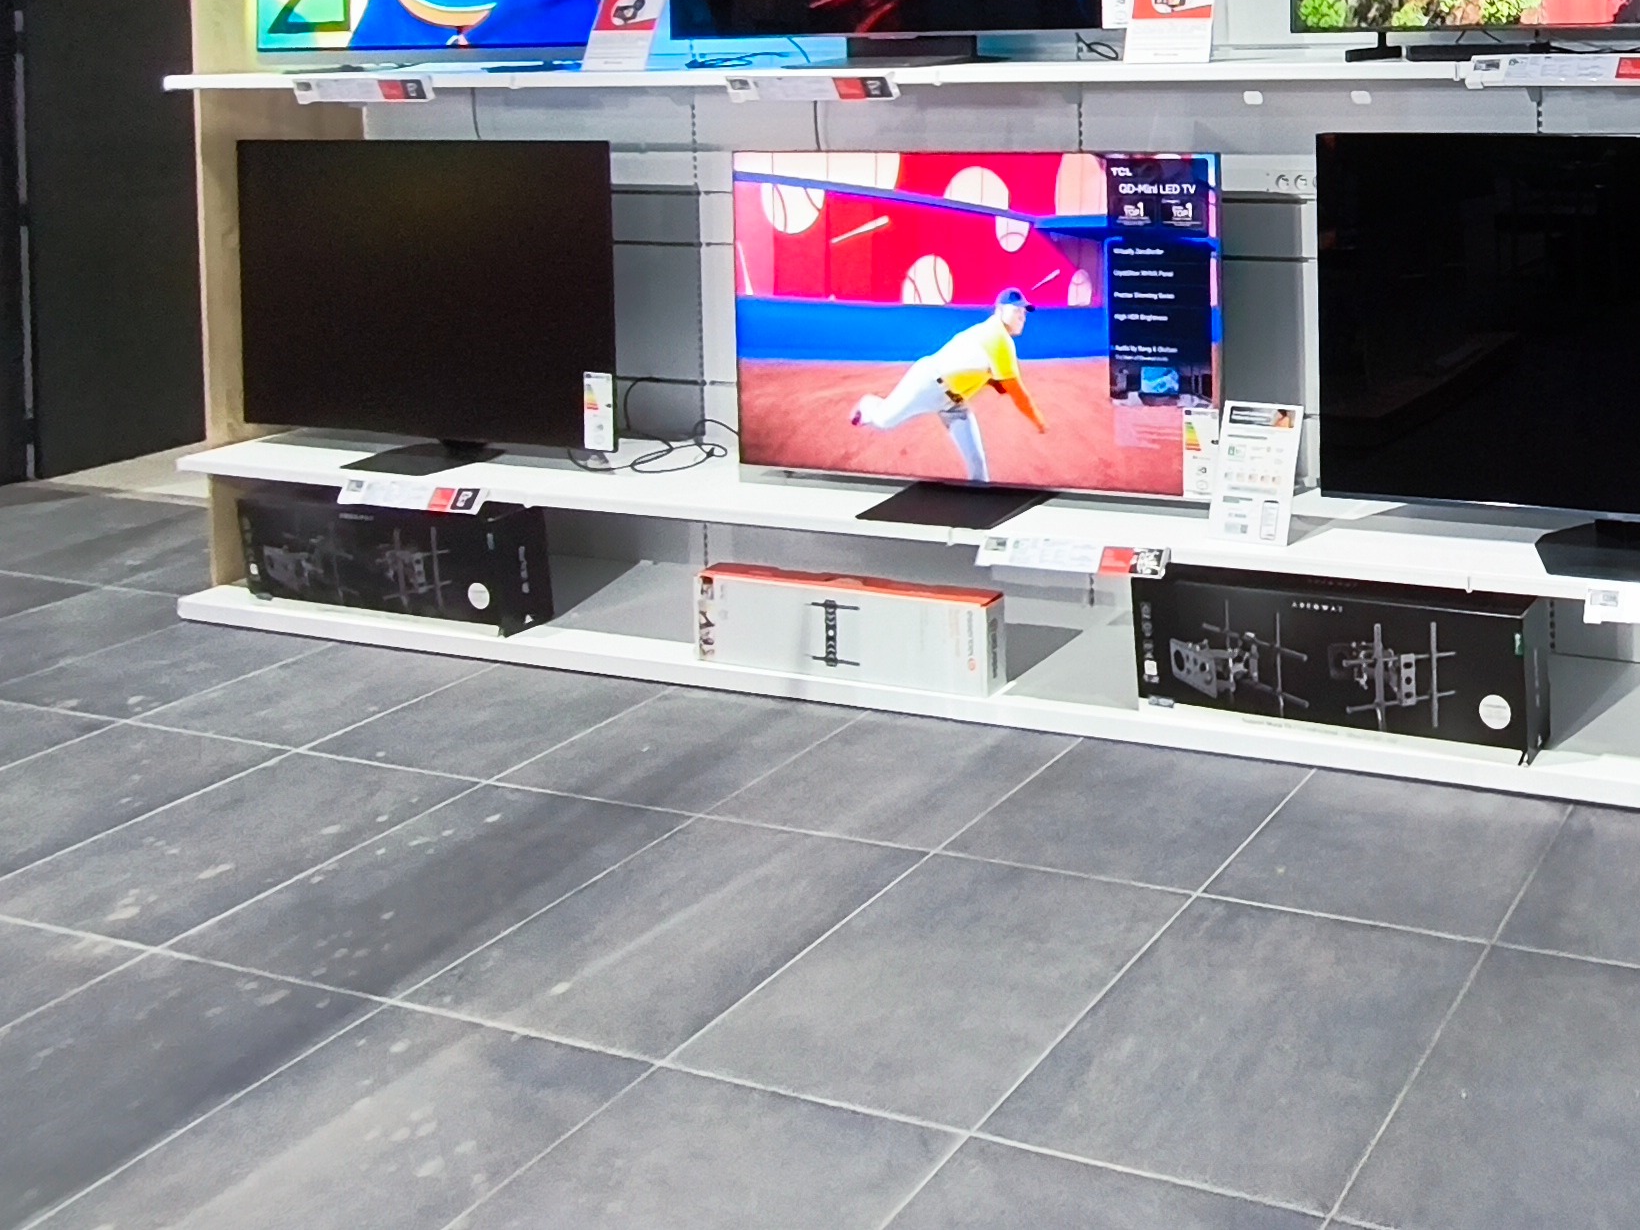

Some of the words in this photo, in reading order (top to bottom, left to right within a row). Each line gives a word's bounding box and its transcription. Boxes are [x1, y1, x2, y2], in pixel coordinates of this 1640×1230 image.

[1110, 167, 1133, 177] TCL
[1159, 183, 1181, 194] LED
[1181, 183, 1196, 194] TV
